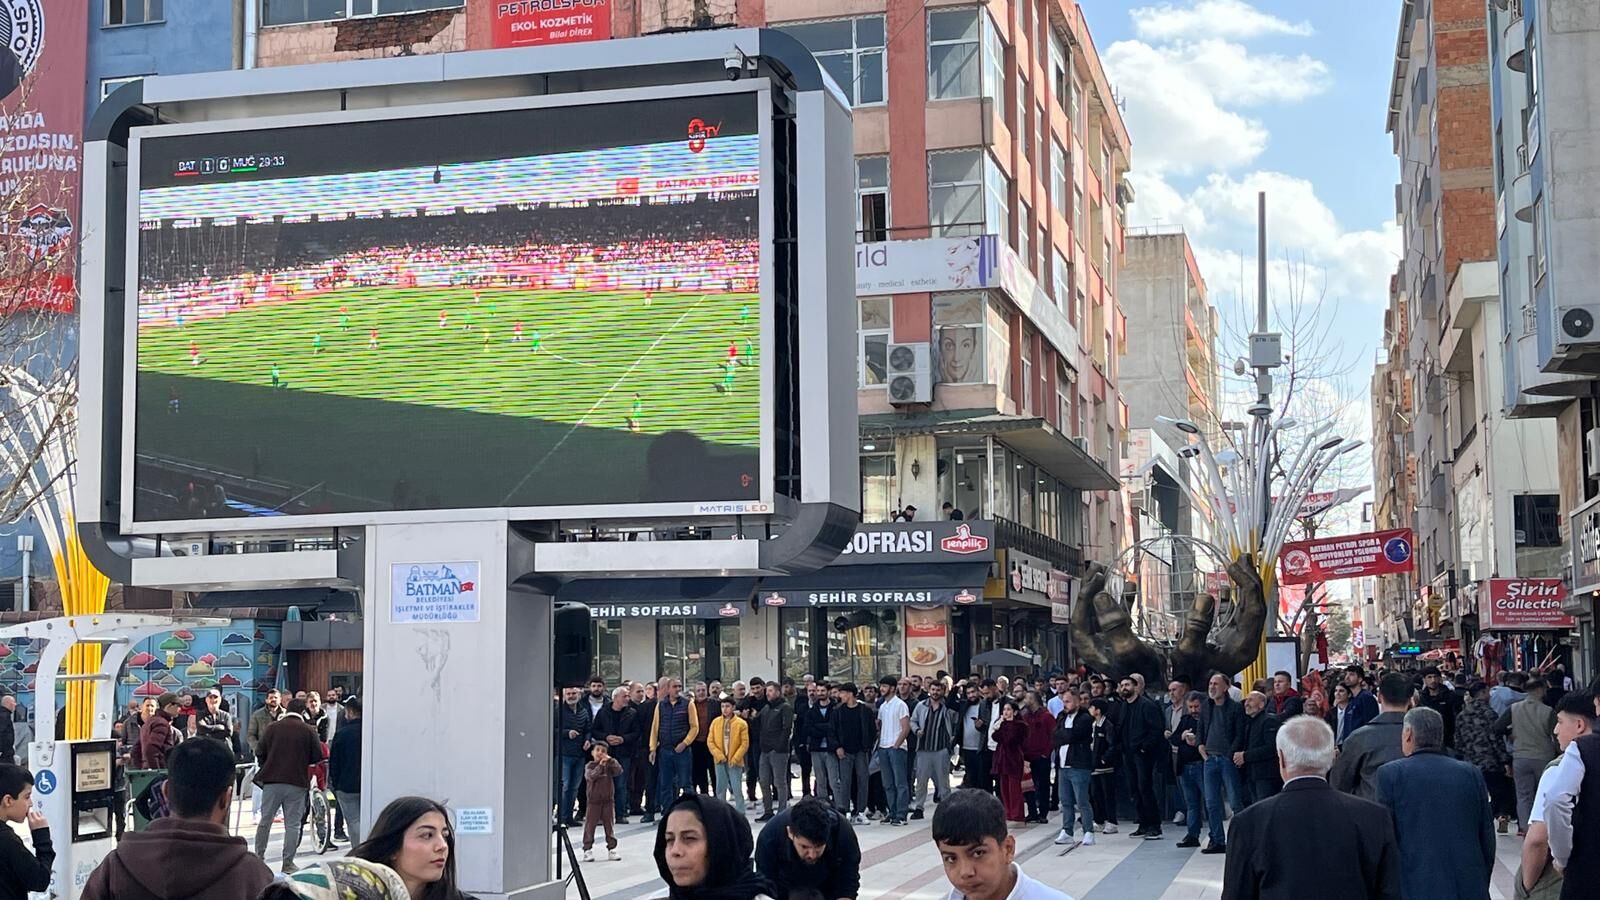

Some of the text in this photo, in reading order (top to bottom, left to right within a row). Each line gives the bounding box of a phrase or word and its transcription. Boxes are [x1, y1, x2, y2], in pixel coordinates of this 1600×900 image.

[511, 13, 593, 32] EKOL KOZMETİK
[549, 29, 568, 39] Bilal
[178, 161, 196, 171] BAT
[219, 159, 228, 170] 0
[878, 279, 905, 289] medical
[946, 538, 981, 550] şenpiliç
[406, 582, 461, 596] BATMAN
[1506, 581, 1558, 600] Şirin
[809, 591, 931, 605] ŞEHİR SOFRASI
[630, 605, 697, 616] SOFRASI
